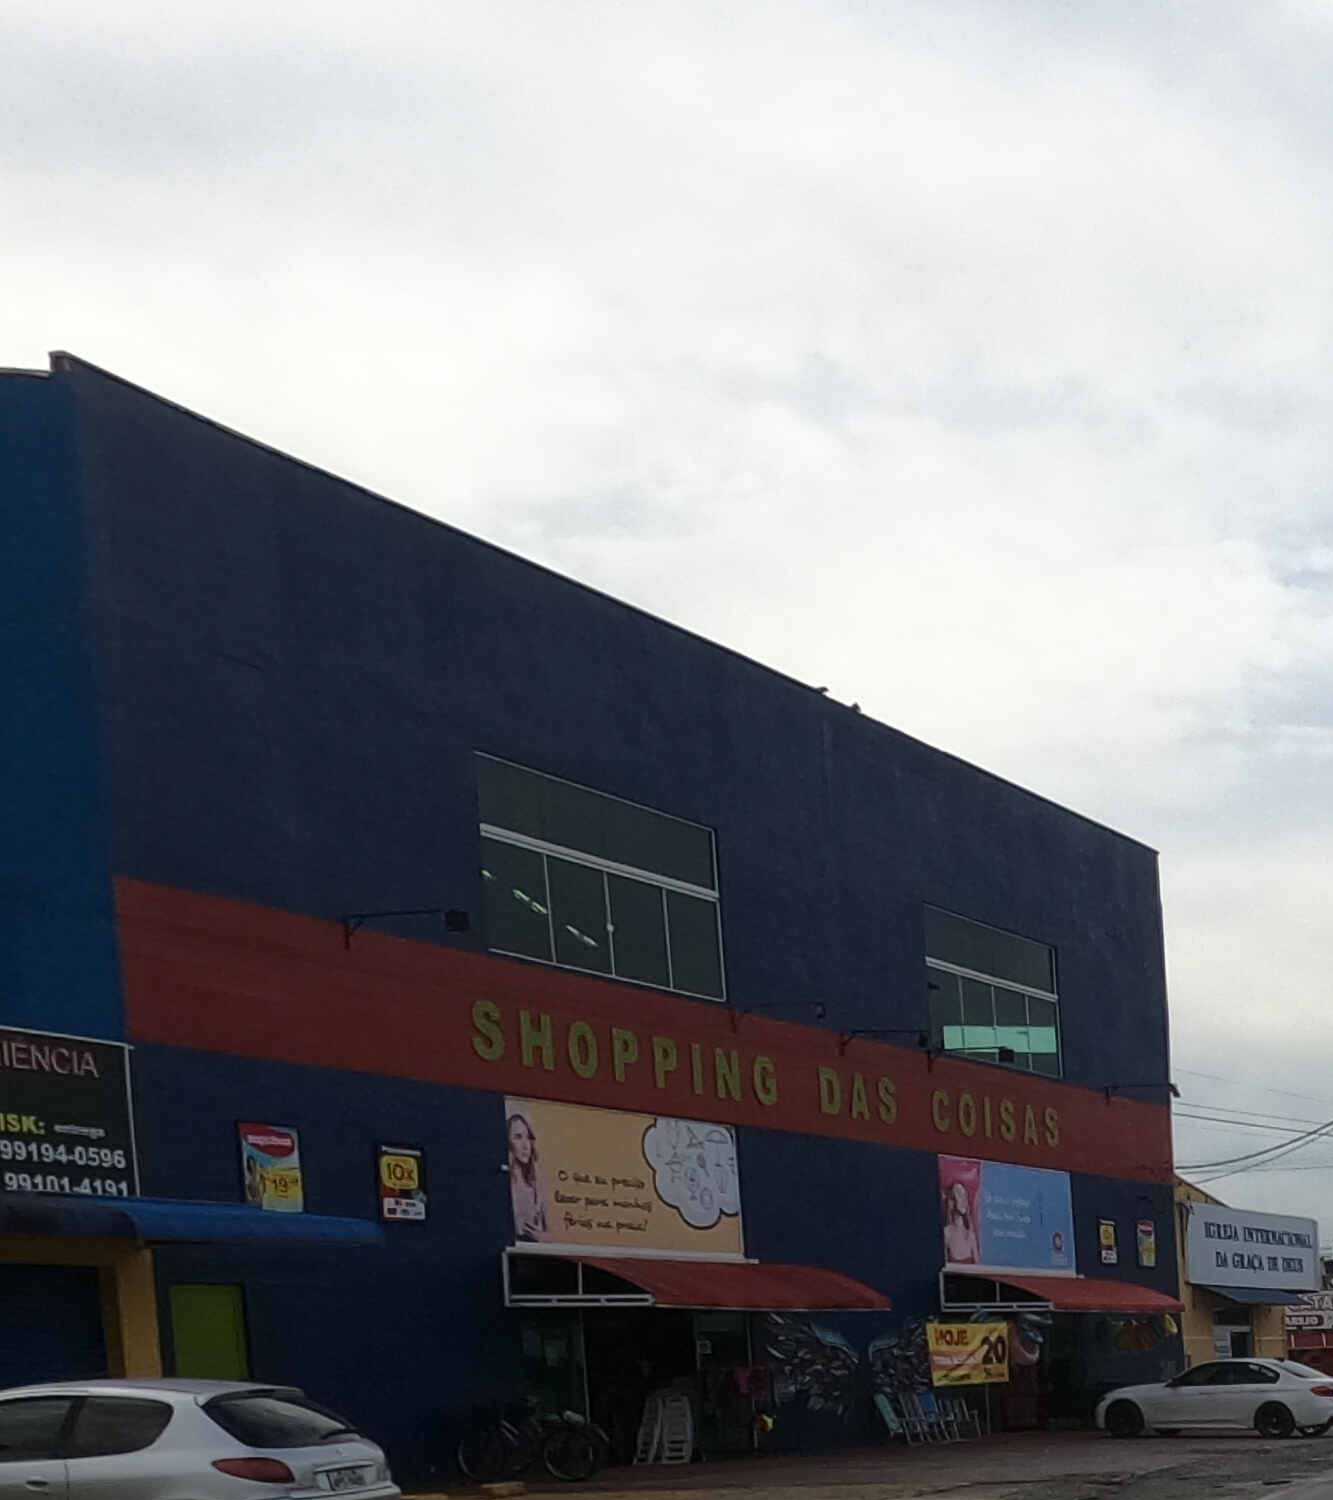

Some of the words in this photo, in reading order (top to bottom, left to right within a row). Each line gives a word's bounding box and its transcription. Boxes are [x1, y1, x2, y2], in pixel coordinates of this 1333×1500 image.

[0, 1037, 99, 1078] IÊNCIA
[471, 1000, 779, 1106] SHOPPING
[818, 1066, 898, 1124] DAS
[930, 1089, 1061, 1146] COISAS
[0, 1140, 127, 1169] 99194-0596
[4, 1172, 129, 1198] 99101-4191
[1204, 1222, 1239, 1241] IGREJA
[1243, 1226, 1312, 1249] INTERNACIONAL
[1215, 1251, 1229, 1267] DA
[1232, 1252, 1264, 1274] GRAÇA
[1268, 1256, 1278, 1272] DE
[934, 1327, 969, 1346] HOJE
[981, 1335, 1006, 1364] 20
